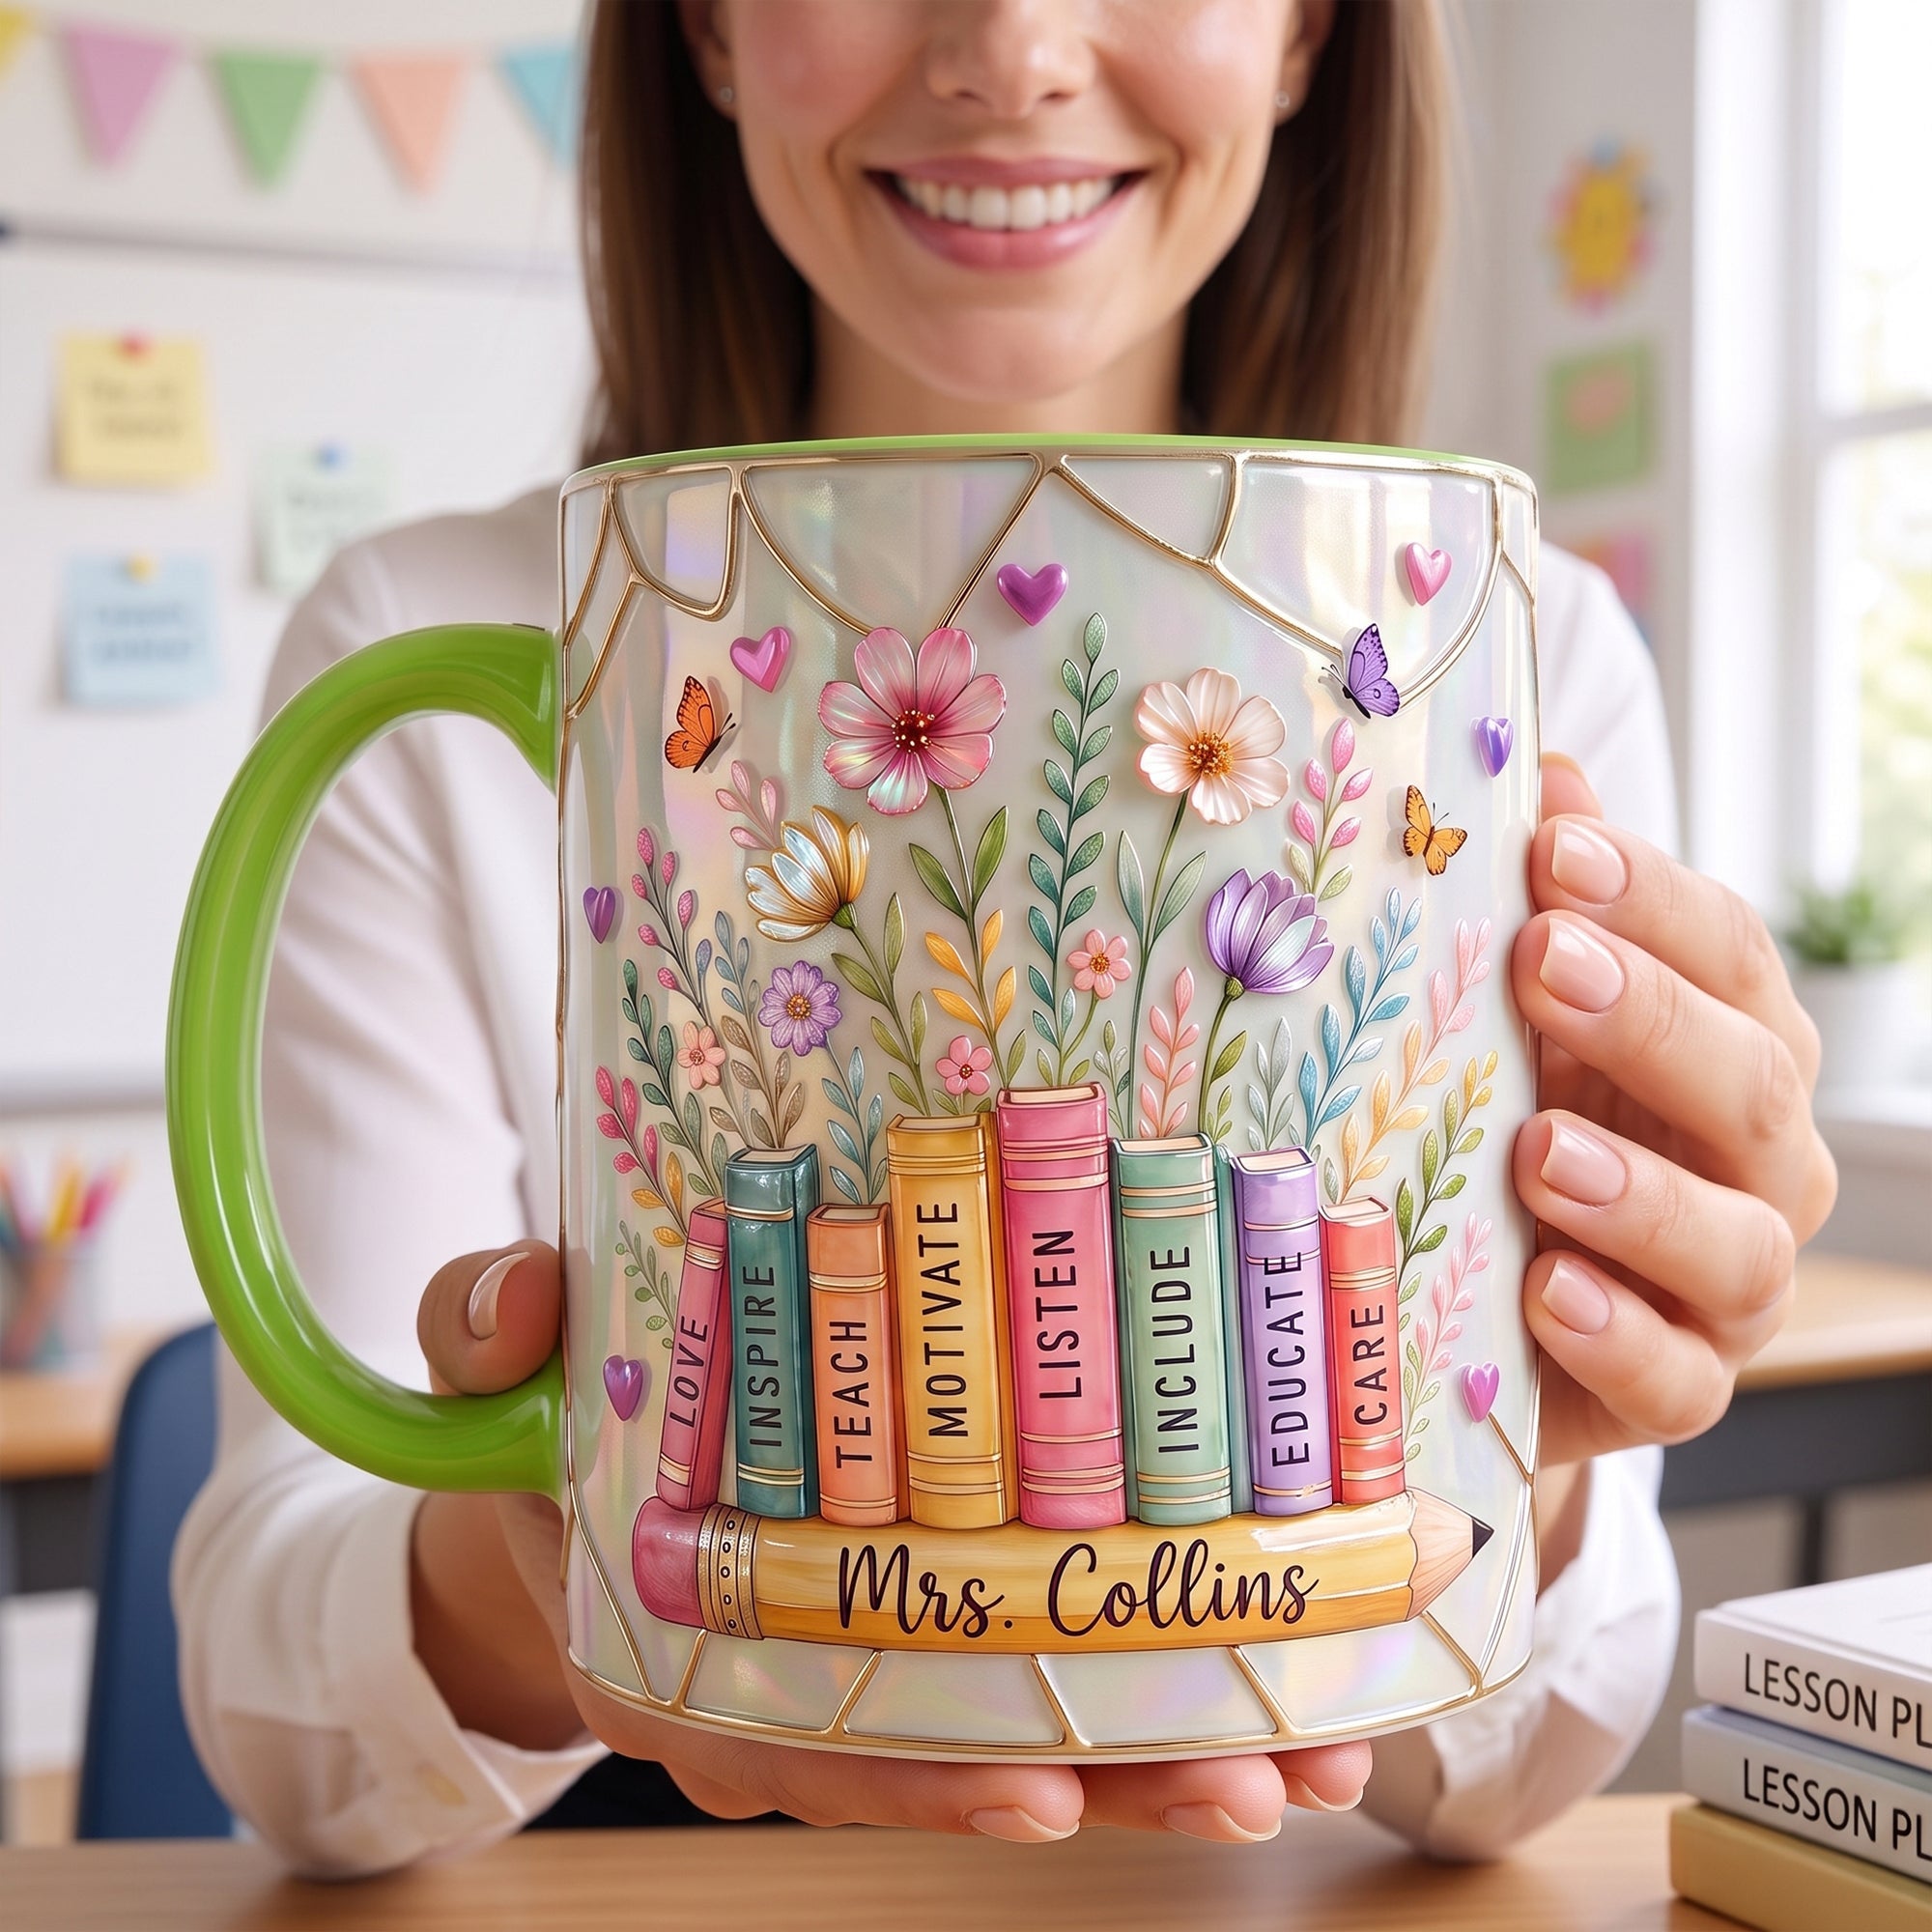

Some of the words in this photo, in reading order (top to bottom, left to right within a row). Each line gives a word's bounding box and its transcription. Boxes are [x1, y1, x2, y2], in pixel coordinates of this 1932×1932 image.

[669, 1315, 708, 1428] LOVE
[743, 1265, 782, 1447] INSPIRE
[917, 1203, 969, 1437] MOTIVATE
[1032, 1230, 1082, 1399] LISTEN
[1151, 1246, 1199, 1453] INCLUDE
[1264, 1251, 1311, 1466] EDUCATE
[1351, 1303, 1387, 1425] CARE
[829, 1321, 872, 1468] TEACH
[838, 1544, 1013, 1638] Mrs.
[1047, 1539, 1320, 1636] Collins
[1745, 1653, 1877, 1732] LESSON
[1744, 1758, 1877, 1843] LESSON
